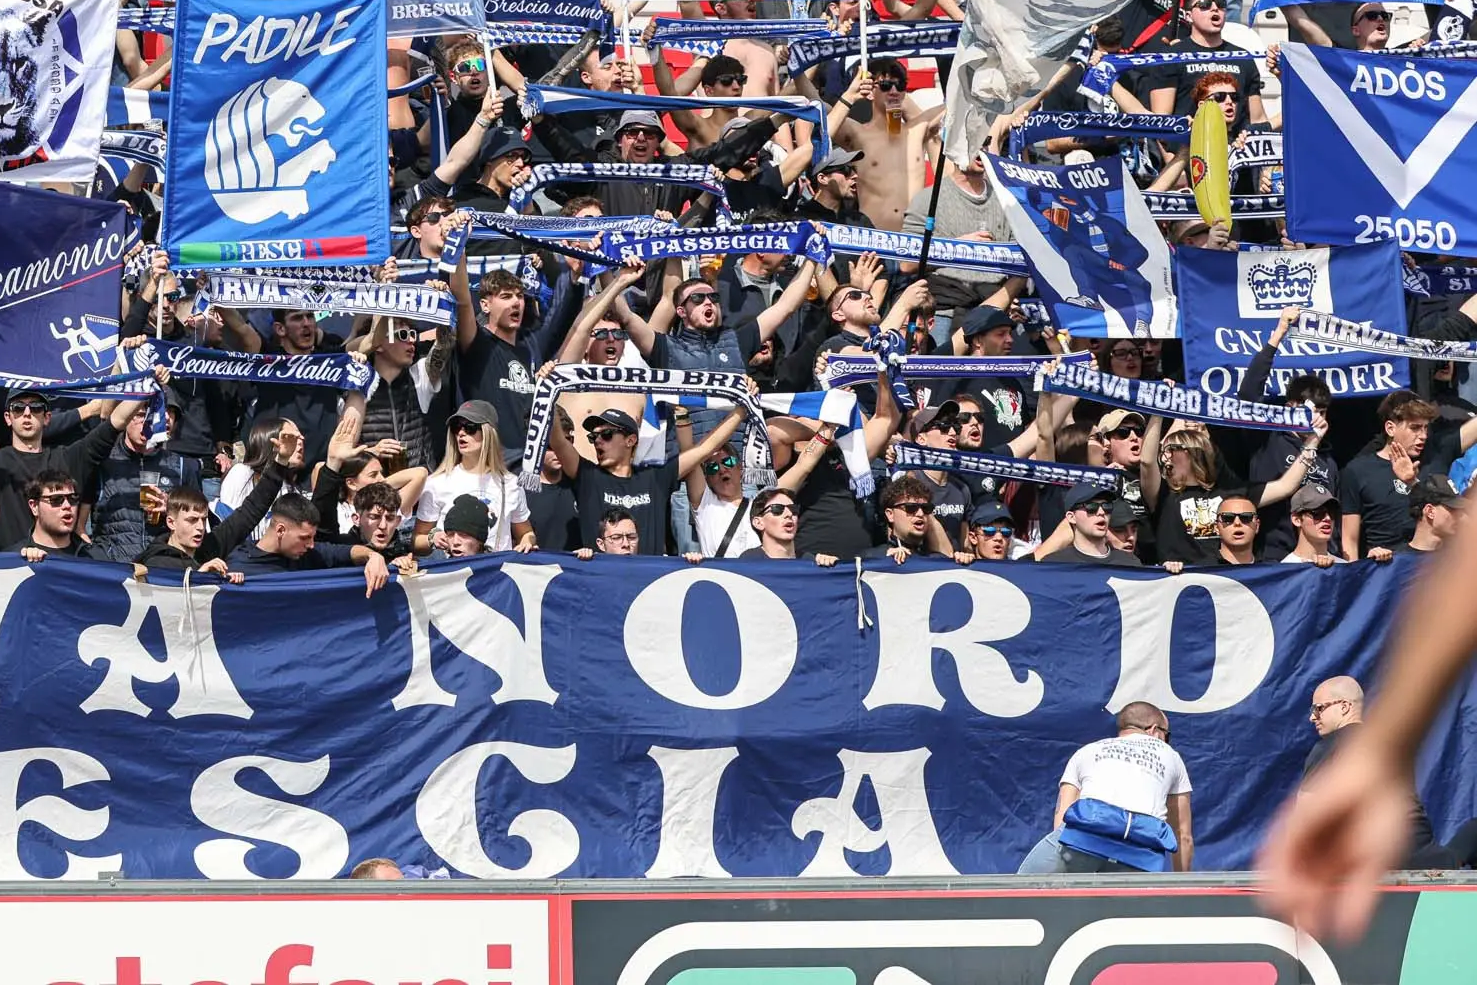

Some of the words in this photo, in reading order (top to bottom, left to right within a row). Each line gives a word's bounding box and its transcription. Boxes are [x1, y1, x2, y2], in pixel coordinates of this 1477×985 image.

[392, 1, 473, 20] BRESCIA
[554, 3, 603, 21] siamo
[193, 5, 357, 65] PADILE
[998, 160, 1063, 189] SEMPER
[620, 244, 648, 261] SI
[652, 234, 791, 257] PASSEGGIA
[1353, 214, 1457, 251] 25050
[219, 240, 324, 263] BRESCIA
[1274, 257, 1292, 266] CNB
[354, 282, 440, 316] NORD
[1297, 311, 1401, 350] CURVA
[167, 346, 254, 378] Leonessa
[257, 353, 346, 383] d'Italia
[1050, 364, 1131, 402] CURVA
[1135, 383, 1202, 416] NORD
[1207, 395, 1311, 428] BRESCIA
[523, 369, 571, 462] CURVA
[574, 367, 671, 384] NORD
[391, 560, 1276, 719] NORD
